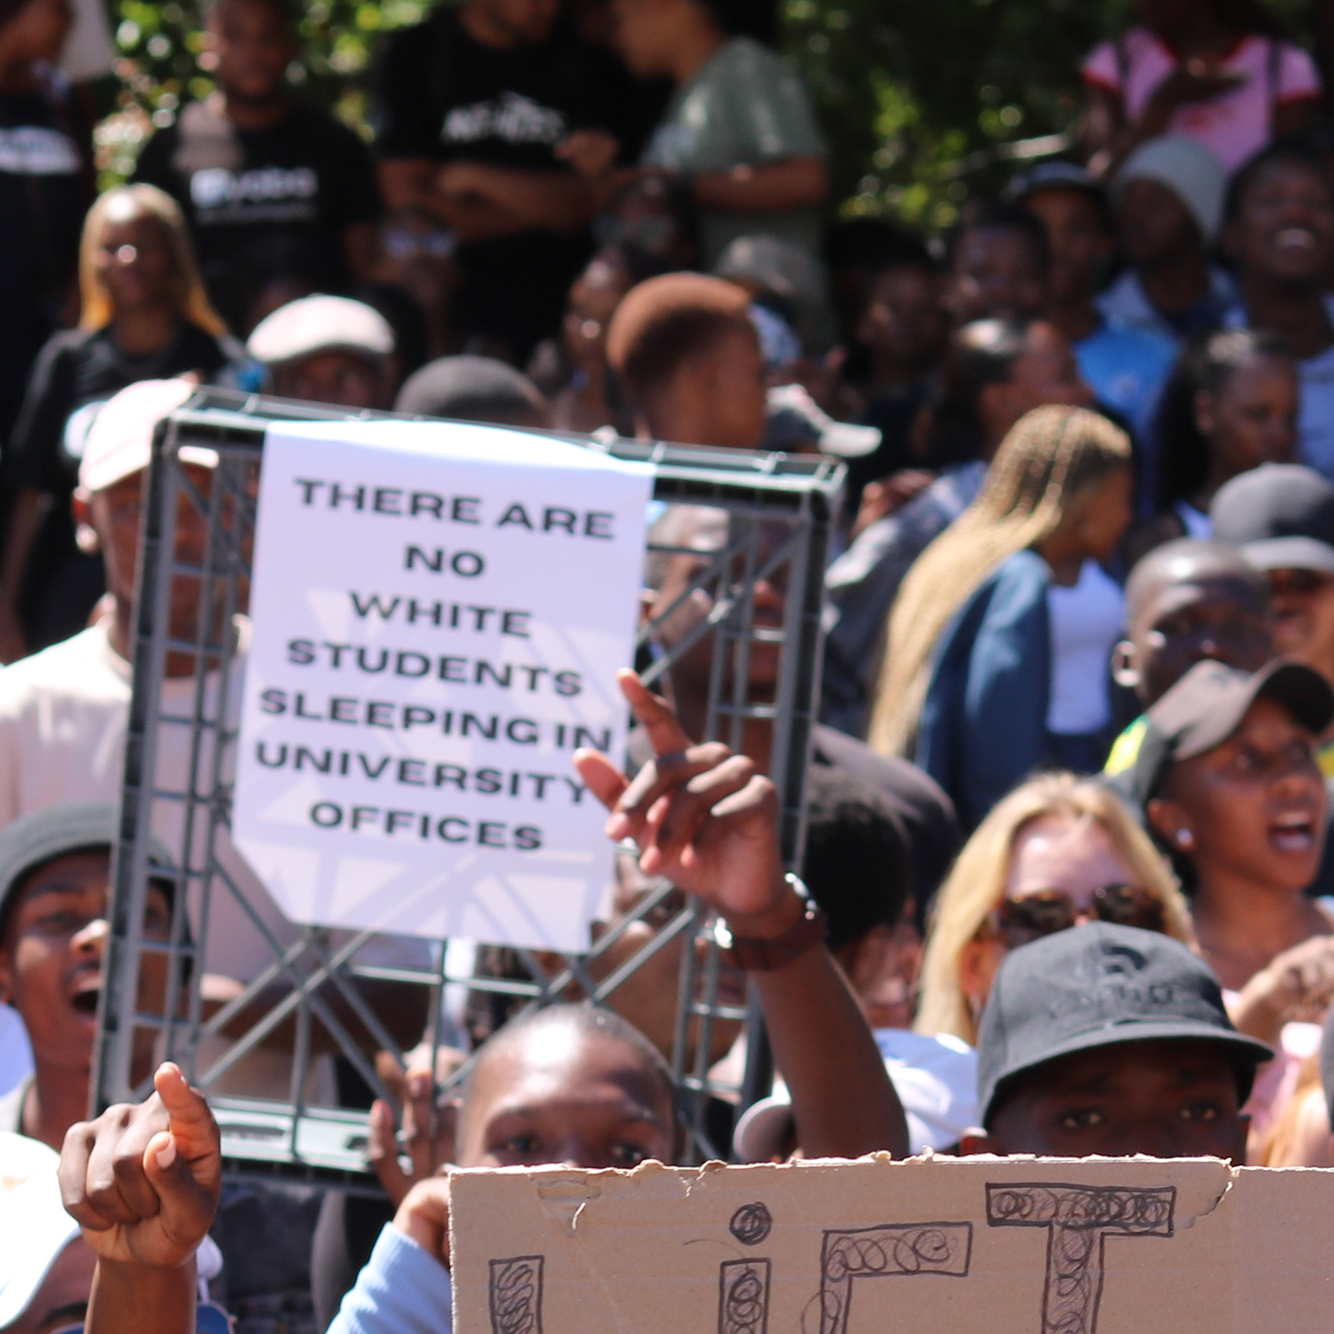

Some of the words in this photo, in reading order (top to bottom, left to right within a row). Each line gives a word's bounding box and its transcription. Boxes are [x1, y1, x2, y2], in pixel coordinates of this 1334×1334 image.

[294, 478, 482, 524] THERE
[496, 502, 616, 541] ARE
[404, 545, 486, 577] NO
[349, 590, 532, 638] WHITE
[287, 639, 583, 697] STUDENTS
[259, 688, 540, 744] SLEEPING
[555, 724, 612, 753] IN
[256, 742, 591, 804] UNIVERSITY
[310, 802, 543, 851] OFFICES
